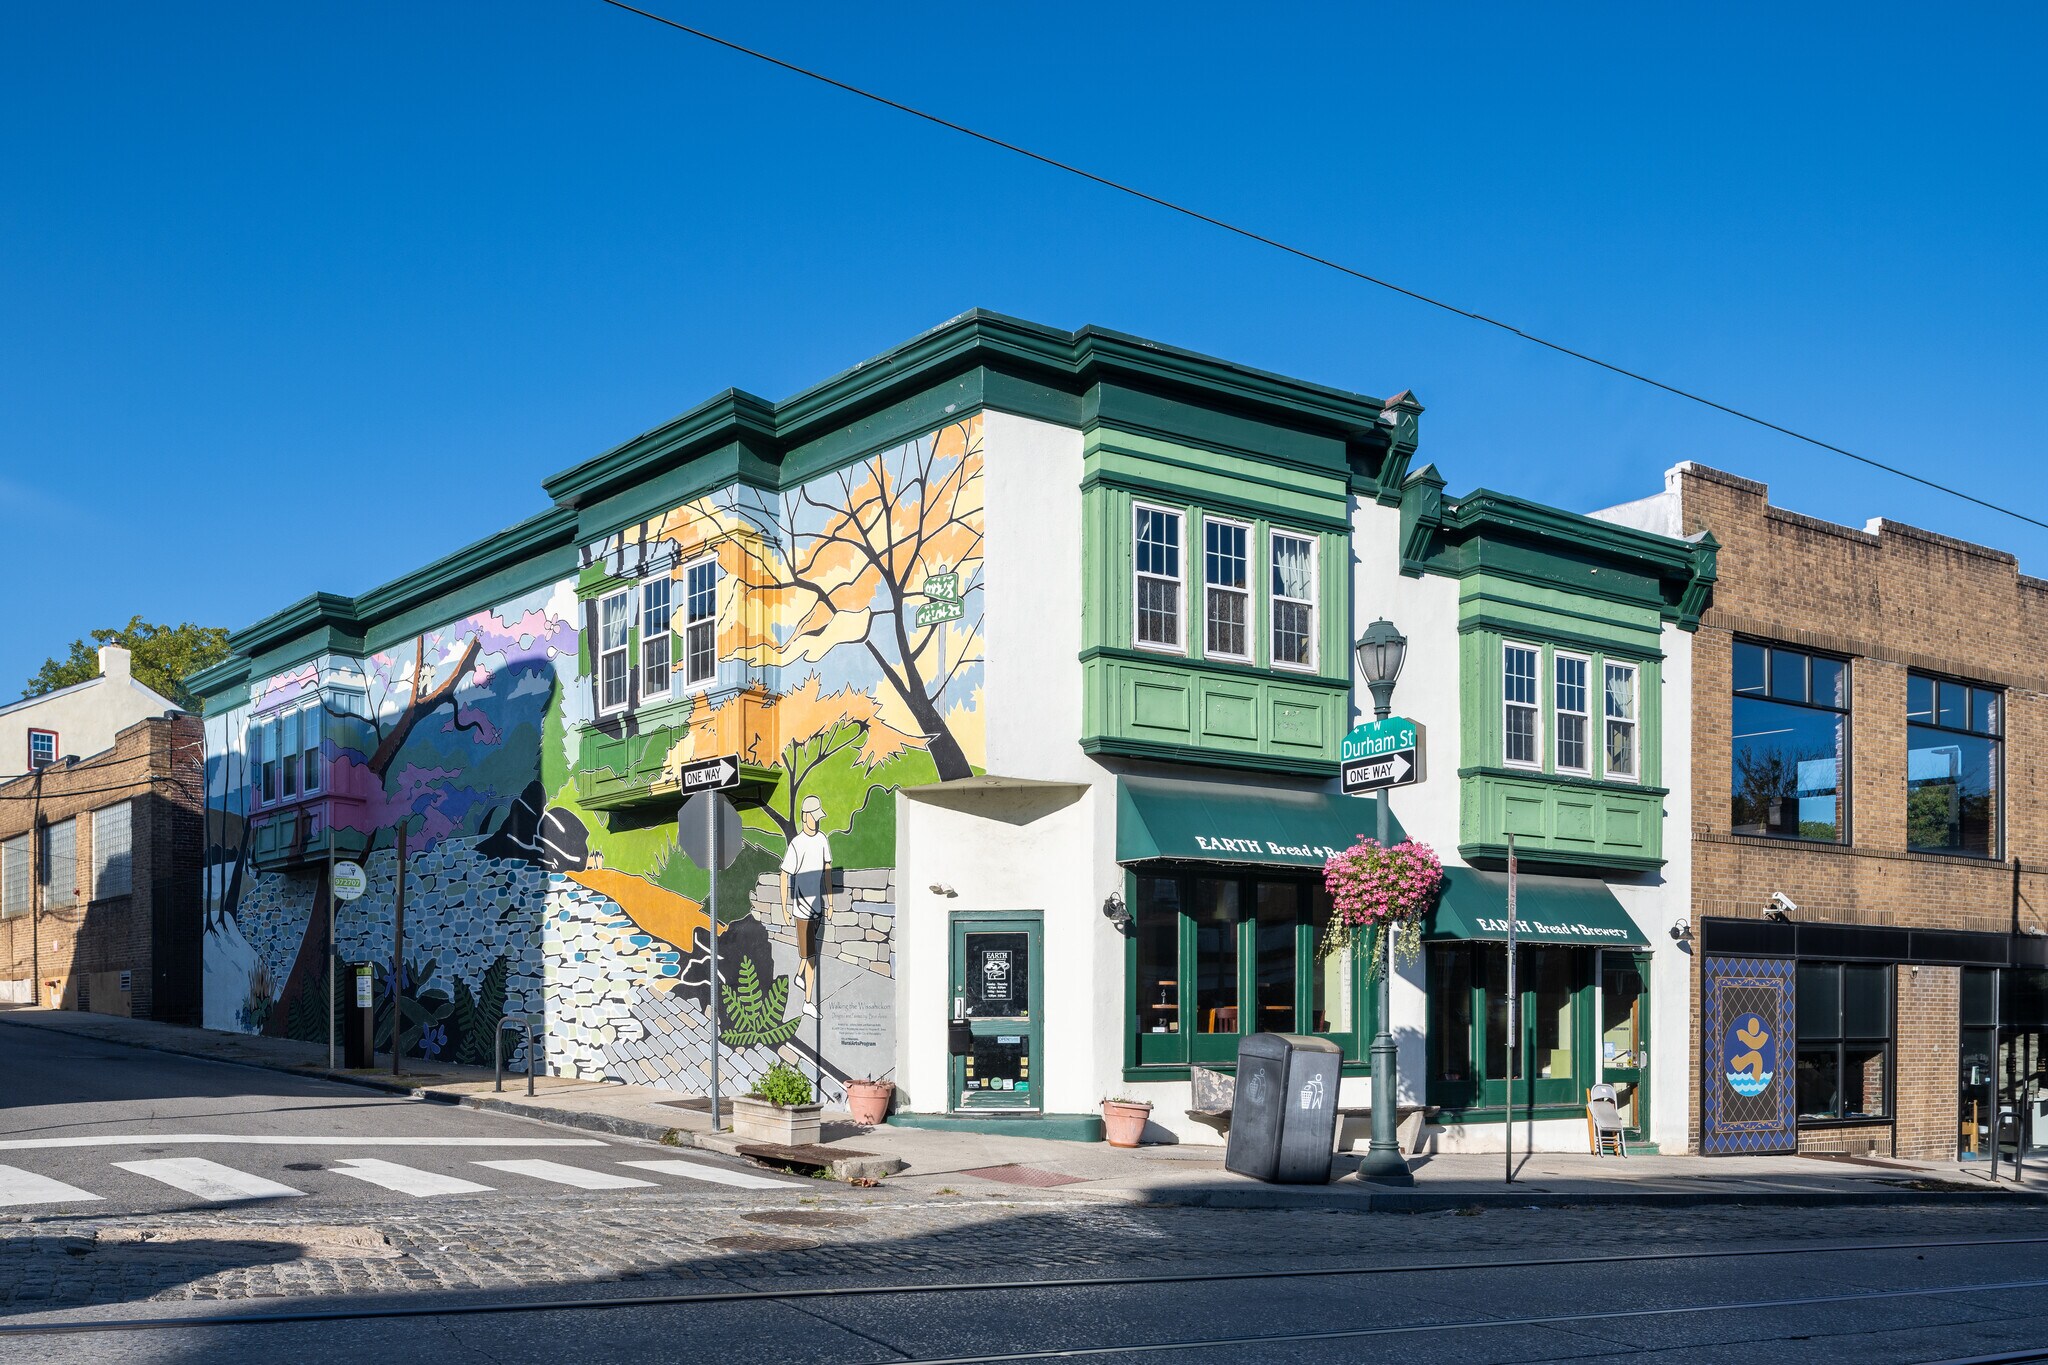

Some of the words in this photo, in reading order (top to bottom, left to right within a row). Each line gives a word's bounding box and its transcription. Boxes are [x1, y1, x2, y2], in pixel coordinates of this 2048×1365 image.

[1373, 720, 1382, 732] W
[1343, 735, 1395, 759] Durham
[1400, 729, 1414, 747] St
[687, 771, 703, 785] ONE
[704, 767, 721, 781] WAY
[1350, 768, 1370, 783] ONE
[1372, 763, 1393, 779] WAY
[1194, 836, 1264, 854] EARTH
[1266, 841, 1313, 857] Bread
[1475, 918, 1533, 933] EARH
[1533, 921, 1572, 935] Bread
[1577, 923, 1628, 939] Brewery
